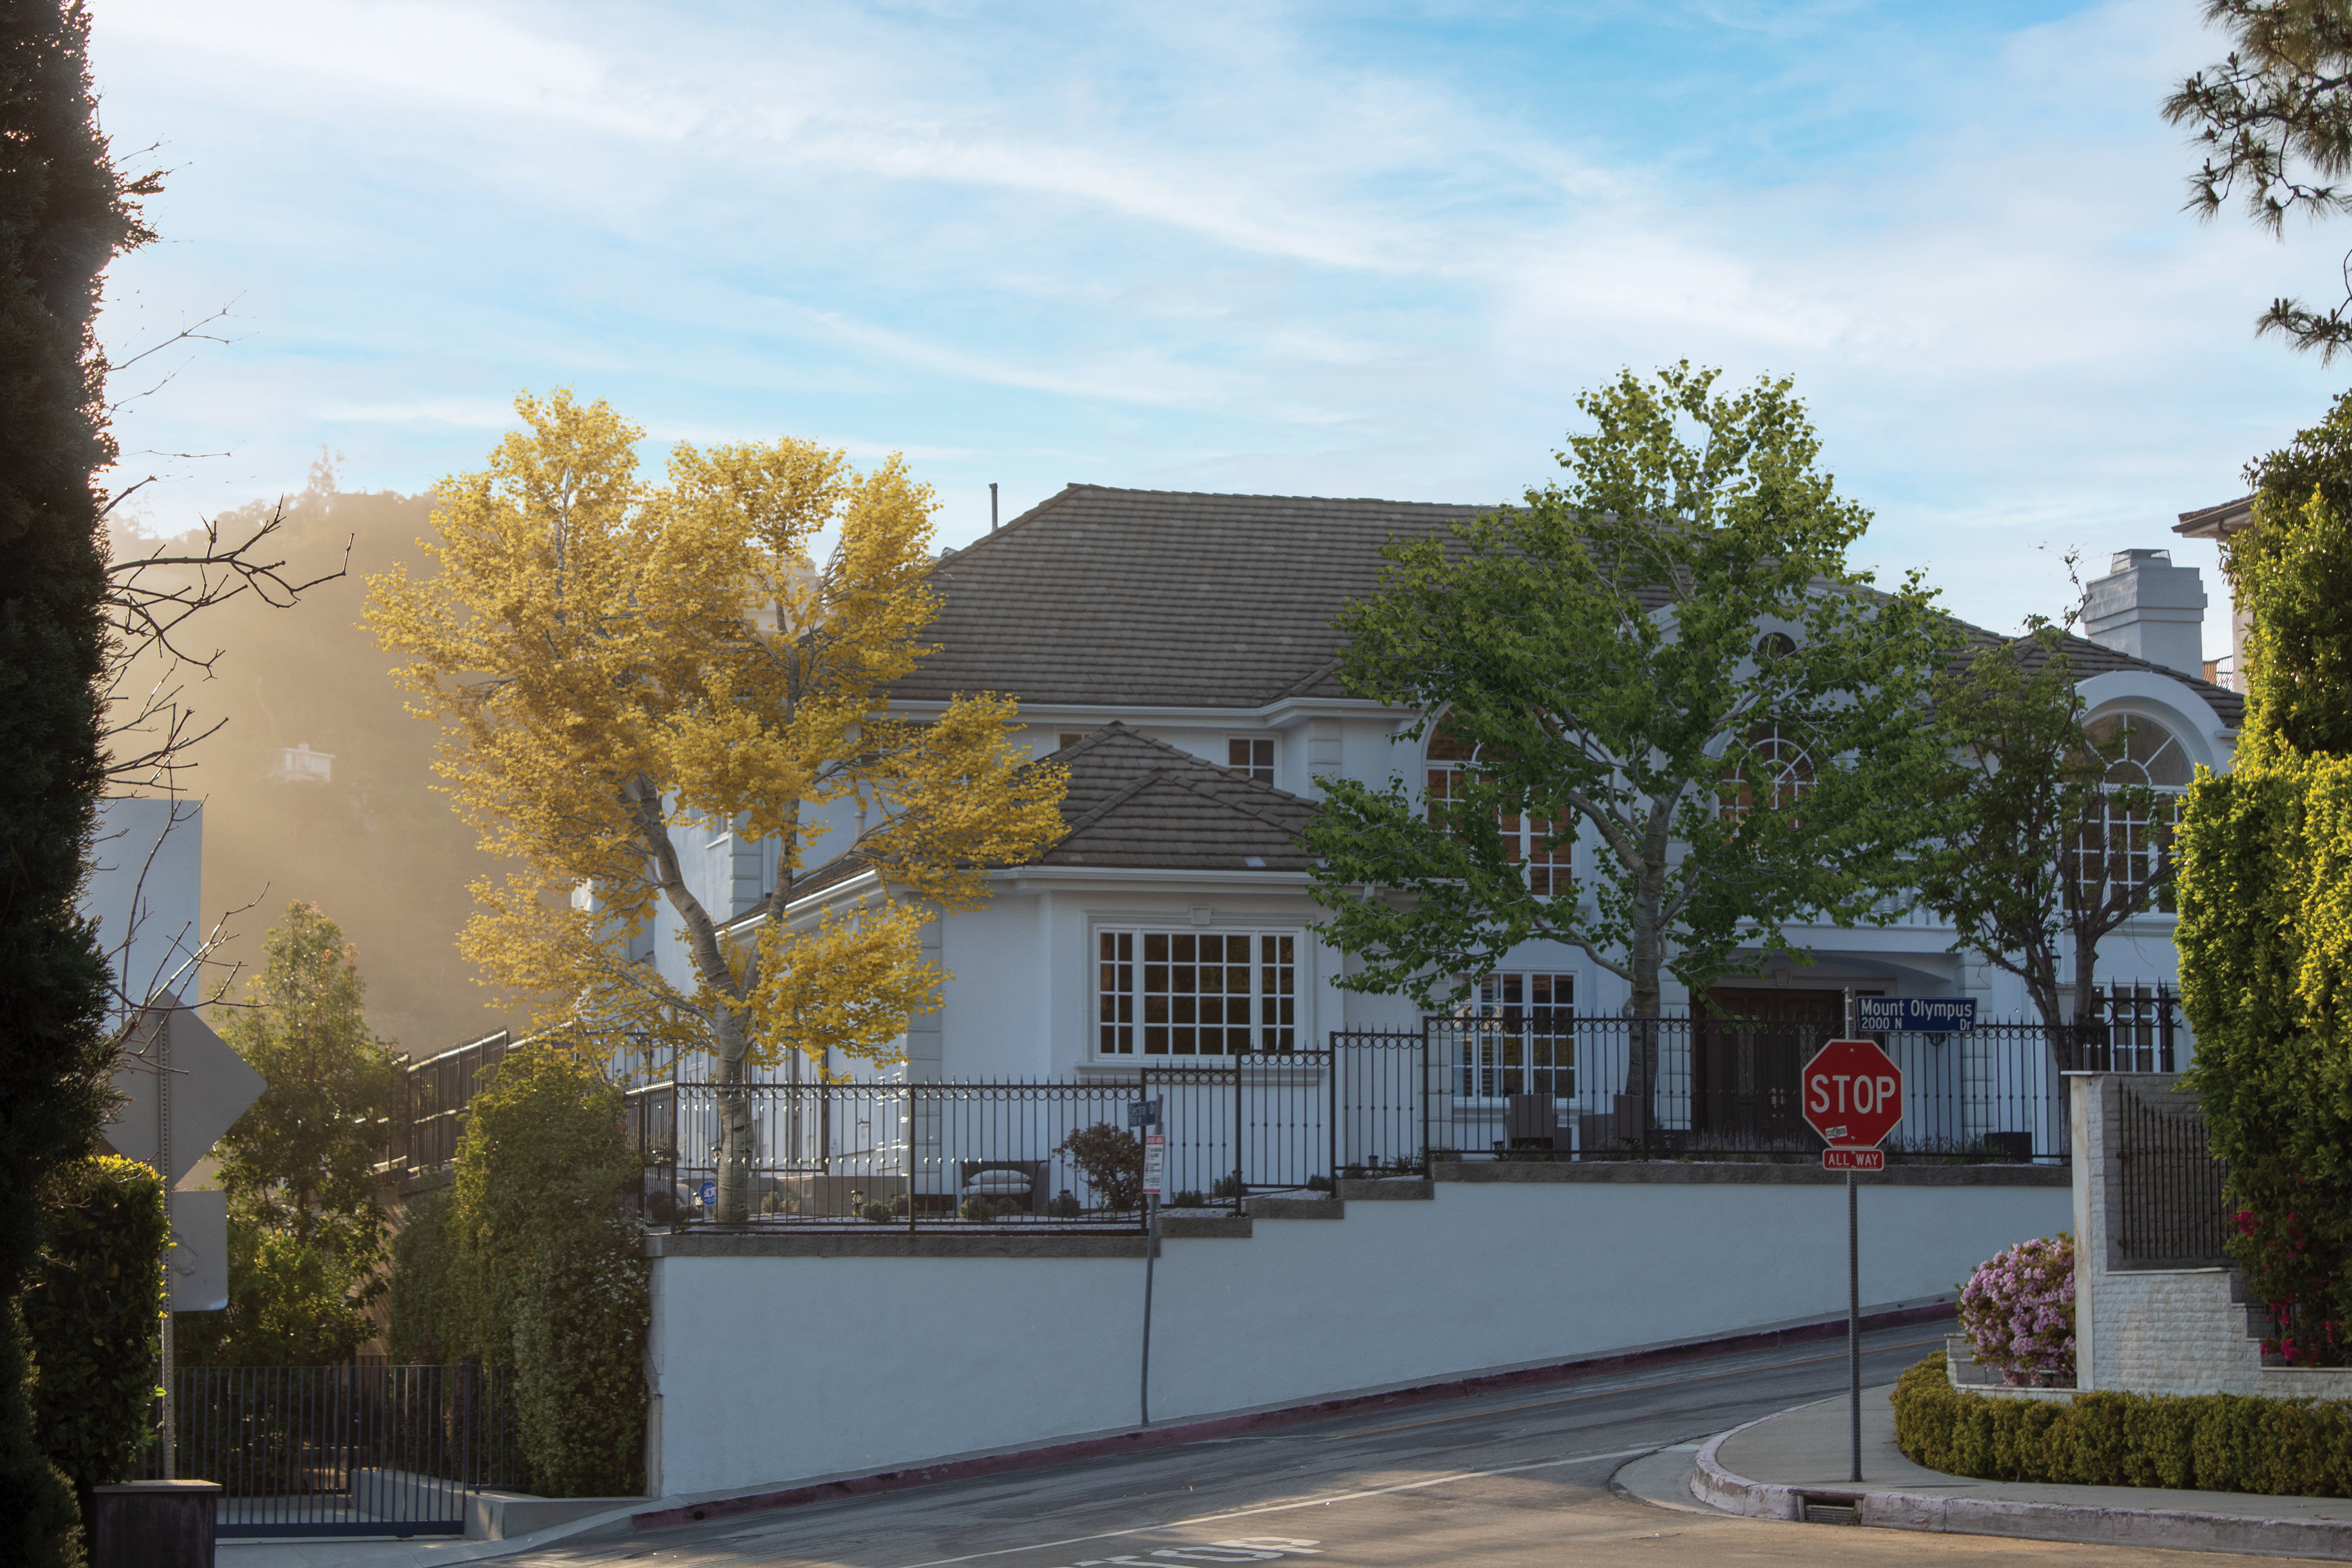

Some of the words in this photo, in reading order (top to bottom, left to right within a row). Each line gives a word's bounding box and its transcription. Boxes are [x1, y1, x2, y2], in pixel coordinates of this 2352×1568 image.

[1861, 999, 1904, 1016] Mount
[1910, 999, 1972, 1021] Olympus
[1861, 1017, 1890, 1030] 2000
[1895, 1018, 1902, 1030] N
[1959, 1019, 1971, 1030] Dr
[1810, 1074, 1896, 1114] STOP
[1828, 1153, 1850, 1166] ALL
[1855, 1153, 1878, 1166] WAY
[1048, 1536, 1325, 1568] TOP
